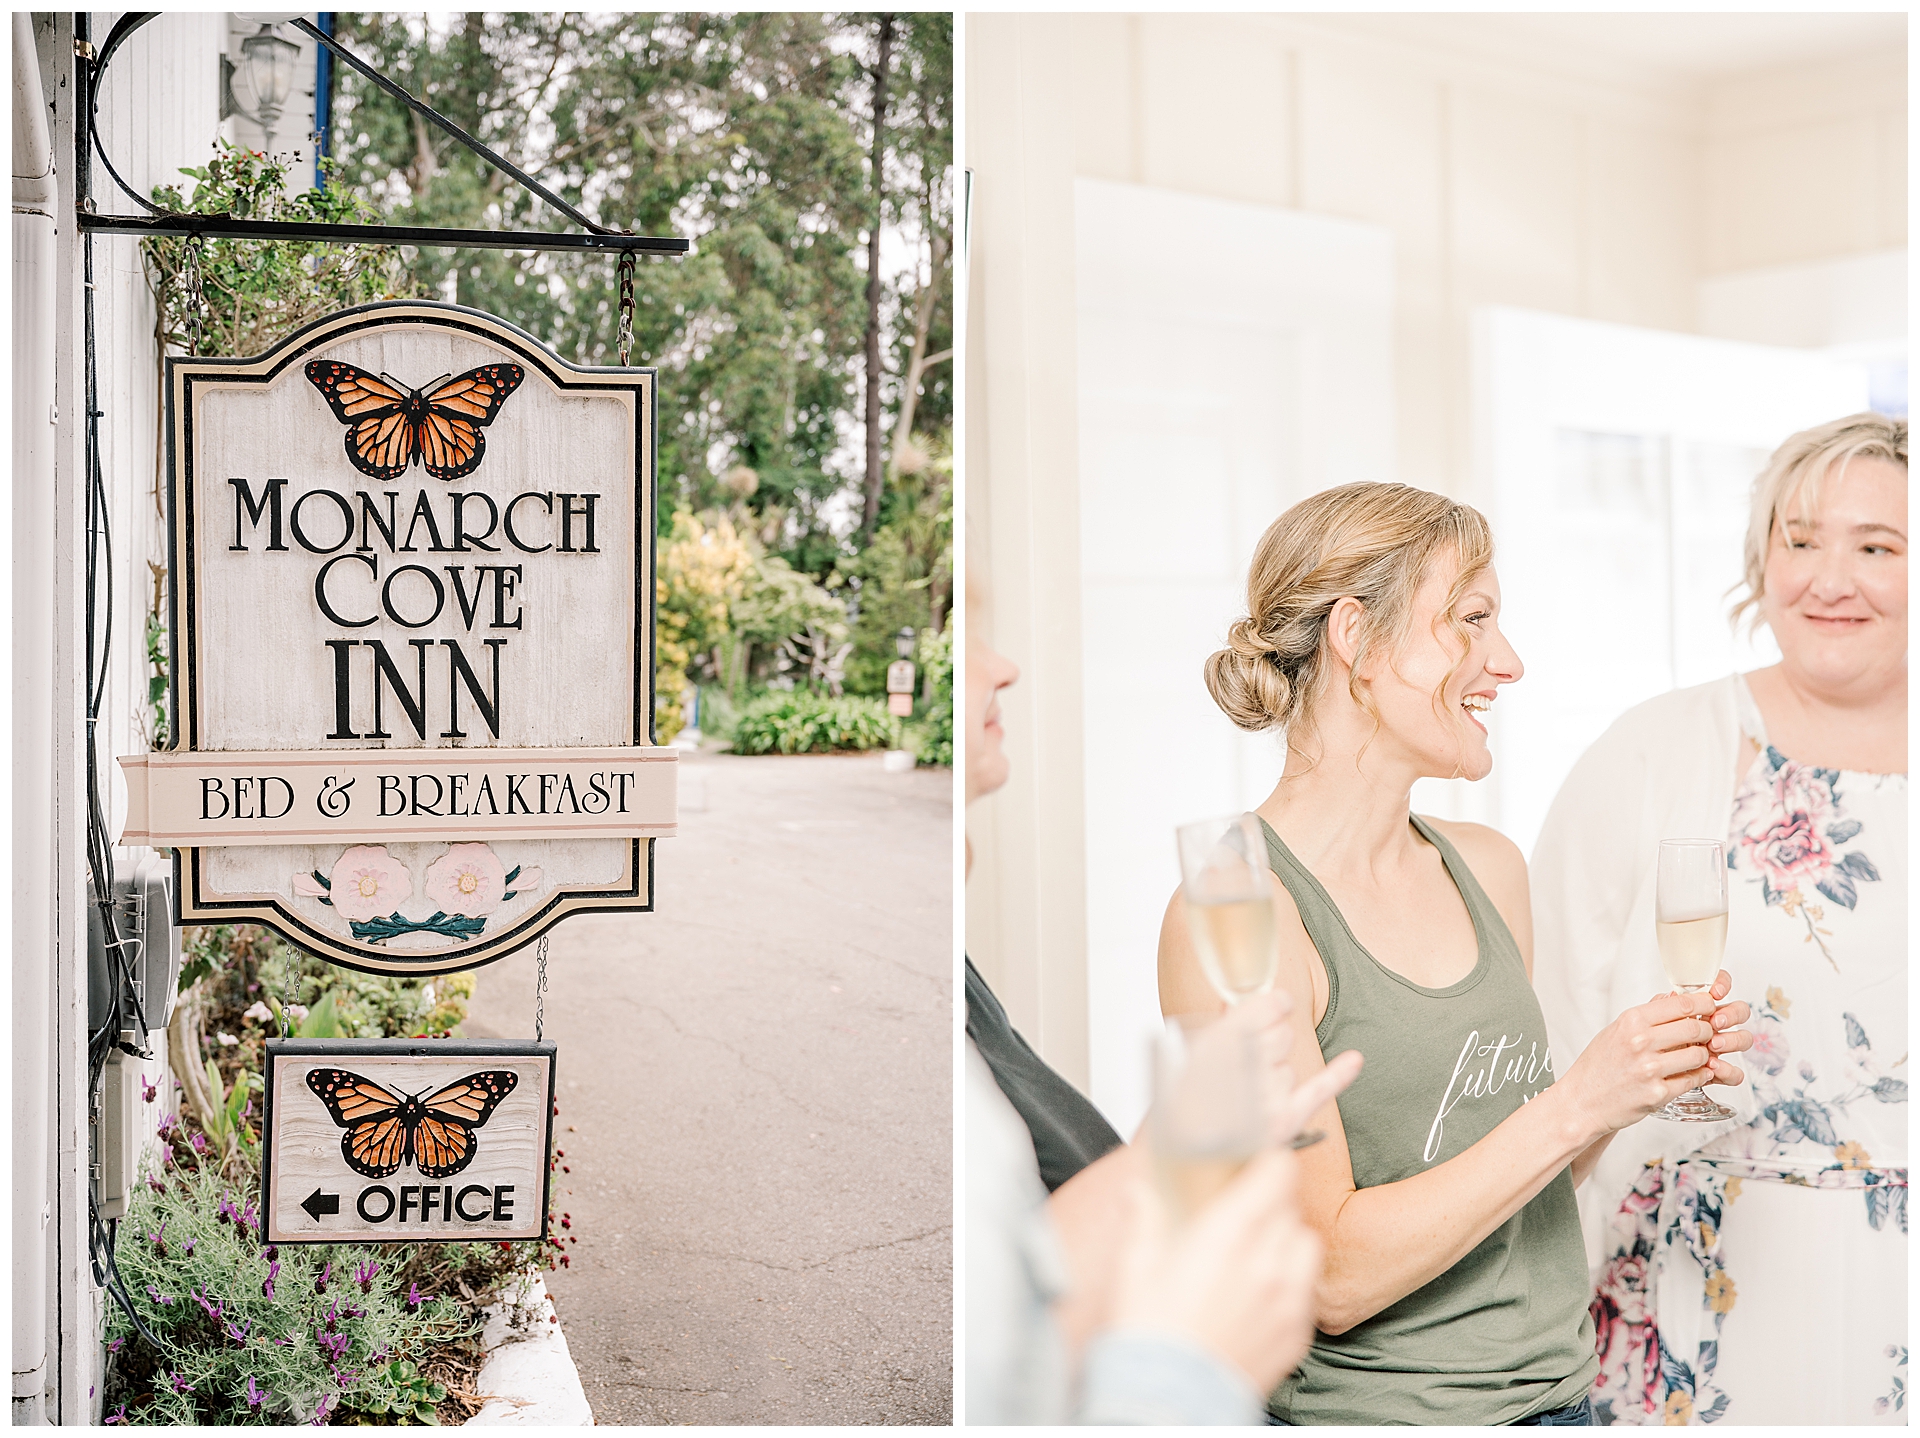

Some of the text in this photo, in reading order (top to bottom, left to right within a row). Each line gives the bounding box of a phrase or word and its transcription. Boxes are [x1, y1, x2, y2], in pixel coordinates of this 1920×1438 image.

[228, 478, 601, 554] MONARCH
[315, 553, 523, 631] COVE
[325, 639, 507, 741] INN
[198, 771, 635, 820] BED & BREAKFAST
[1423, 1030, 1553, 1162] future
[356, 1185, 515, 1224] OFFICE
